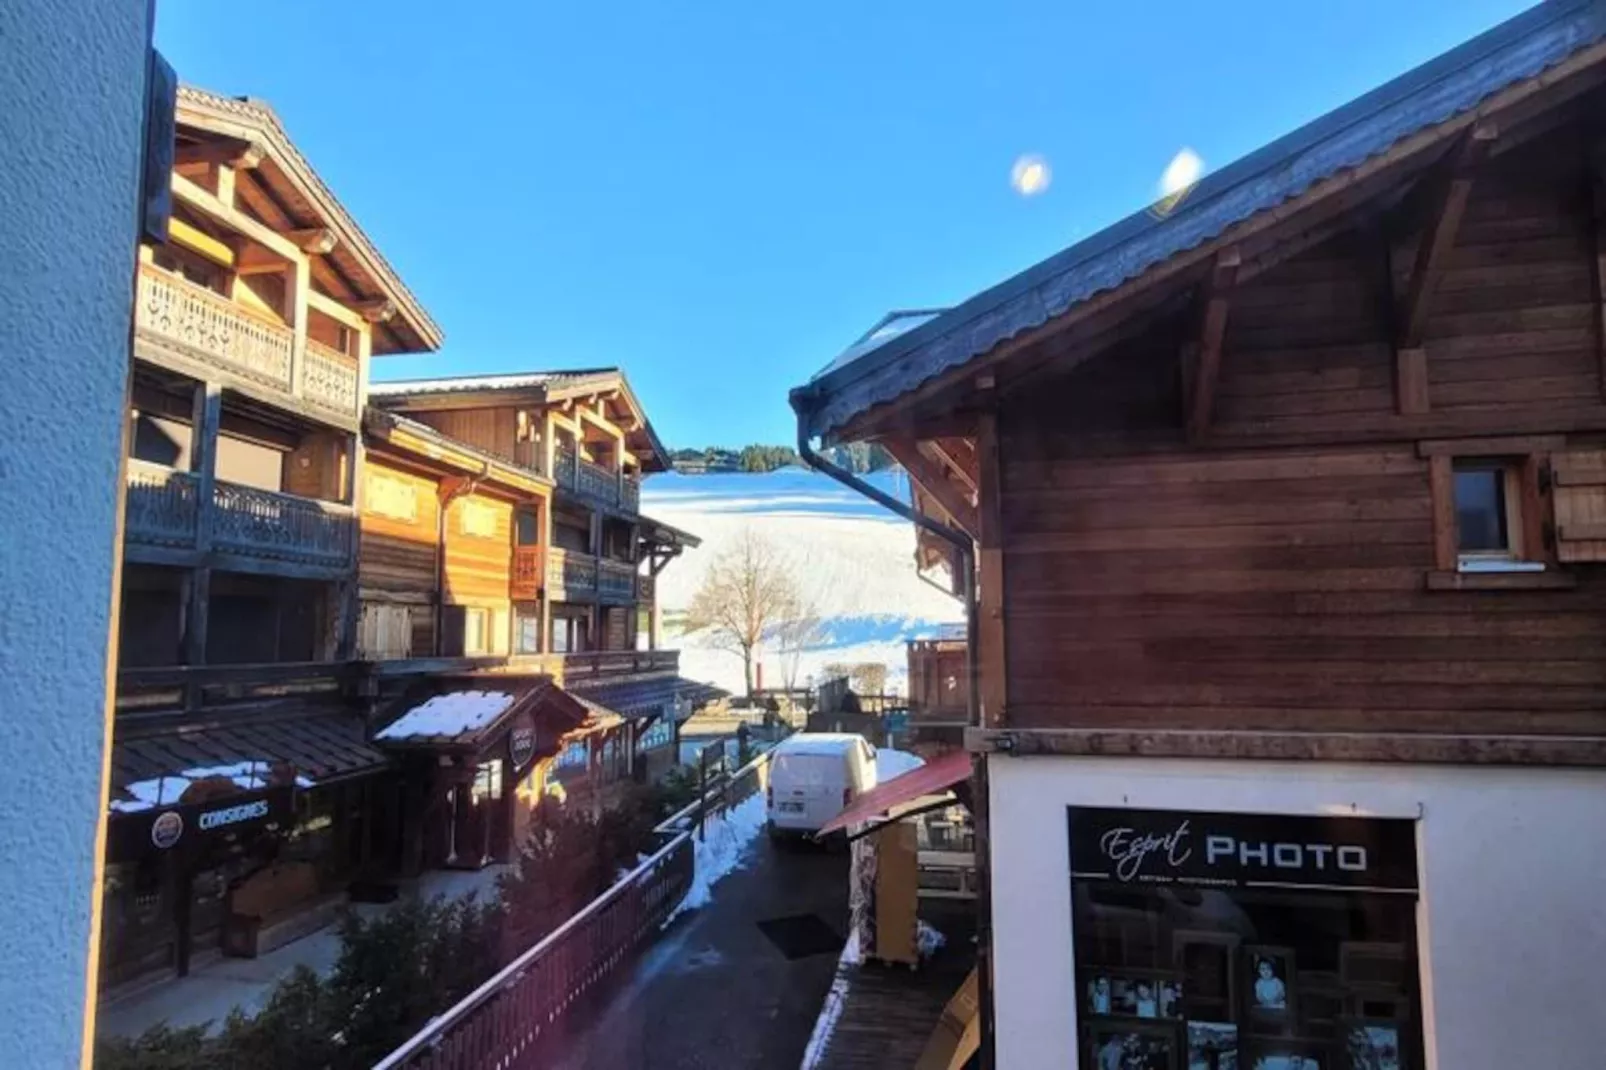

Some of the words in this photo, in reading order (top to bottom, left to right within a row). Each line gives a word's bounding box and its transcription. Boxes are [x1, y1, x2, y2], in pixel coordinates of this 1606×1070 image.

[199, 800, 269, 830] CONSIGNES
[1100, 820, 1192, 881] Esprit
[1206, 835, 1367, 871] PHOTO
